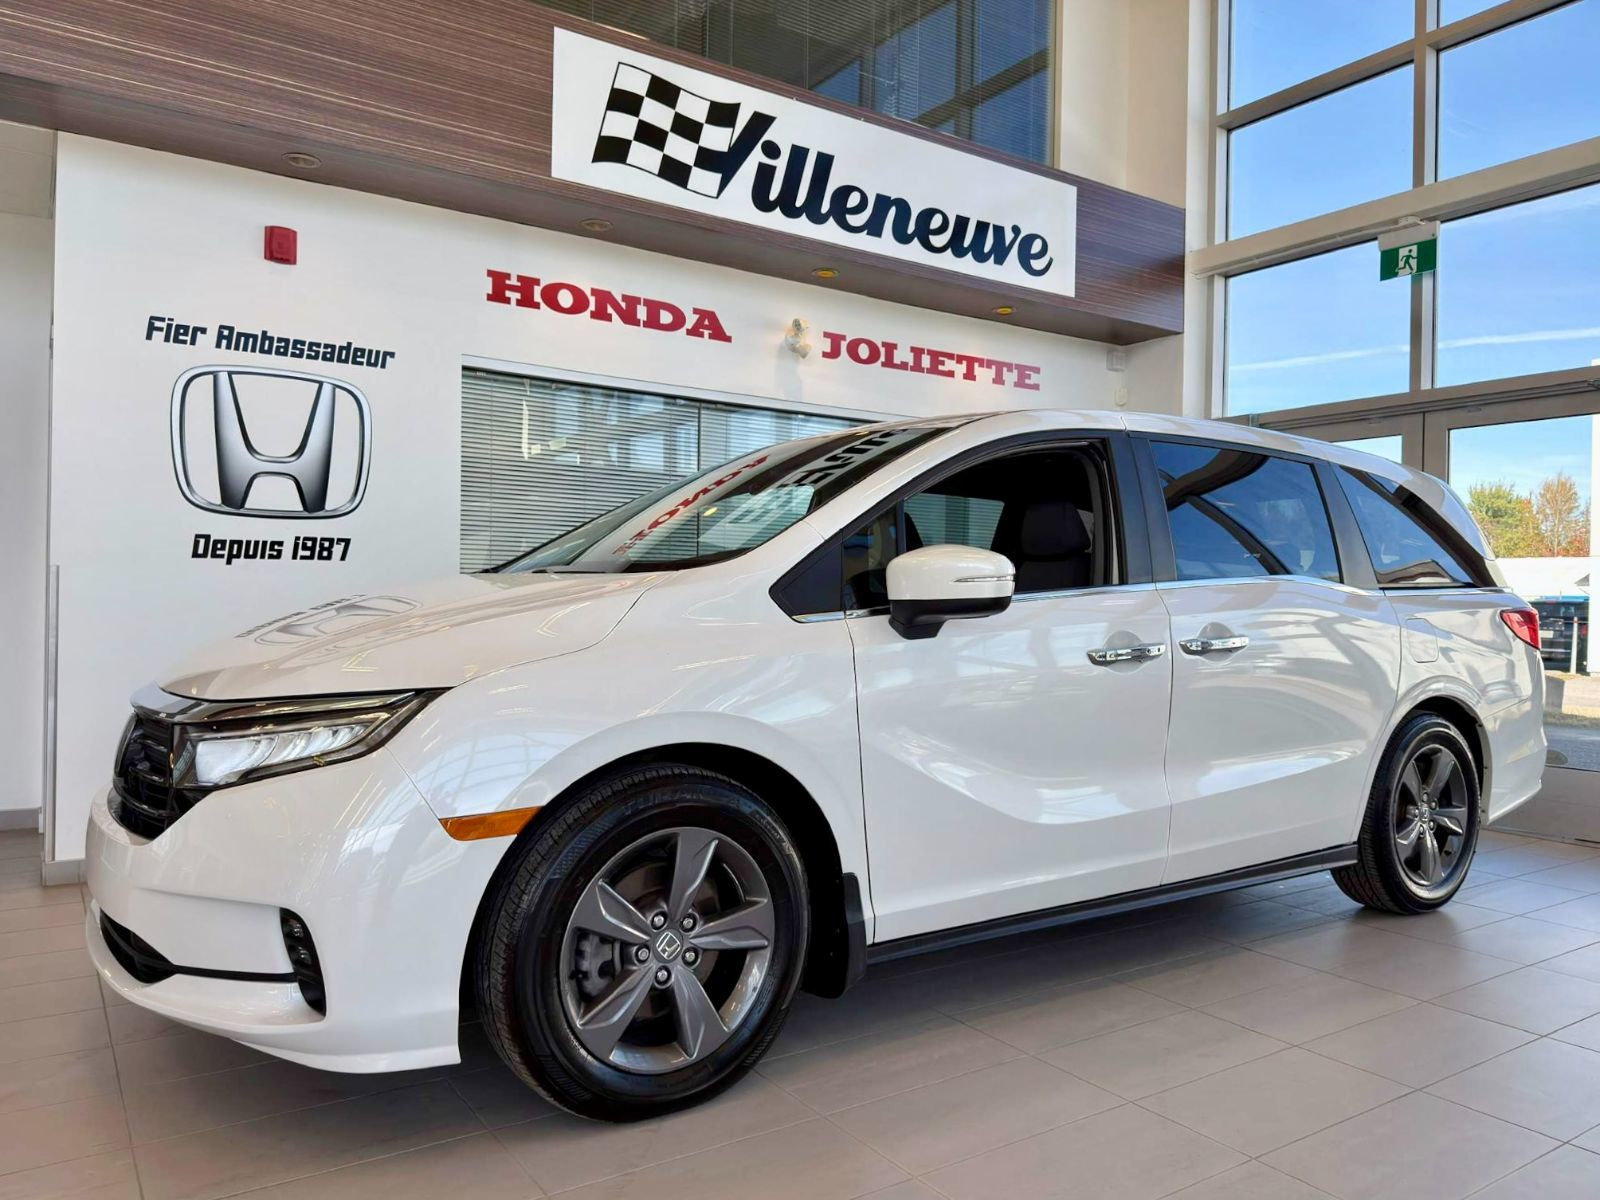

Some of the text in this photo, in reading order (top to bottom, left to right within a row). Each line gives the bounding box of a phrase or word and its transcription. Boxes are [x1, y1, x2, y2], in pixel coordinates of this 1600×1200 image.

[717, 110, 1053, 277] Villeneuve
[145, 315, 396, 369] Fier Ambassadeur
[485, 269, 1042, 391] HONDA JOLIETTE
[191, 533, 352, 566] Depuis 1987
